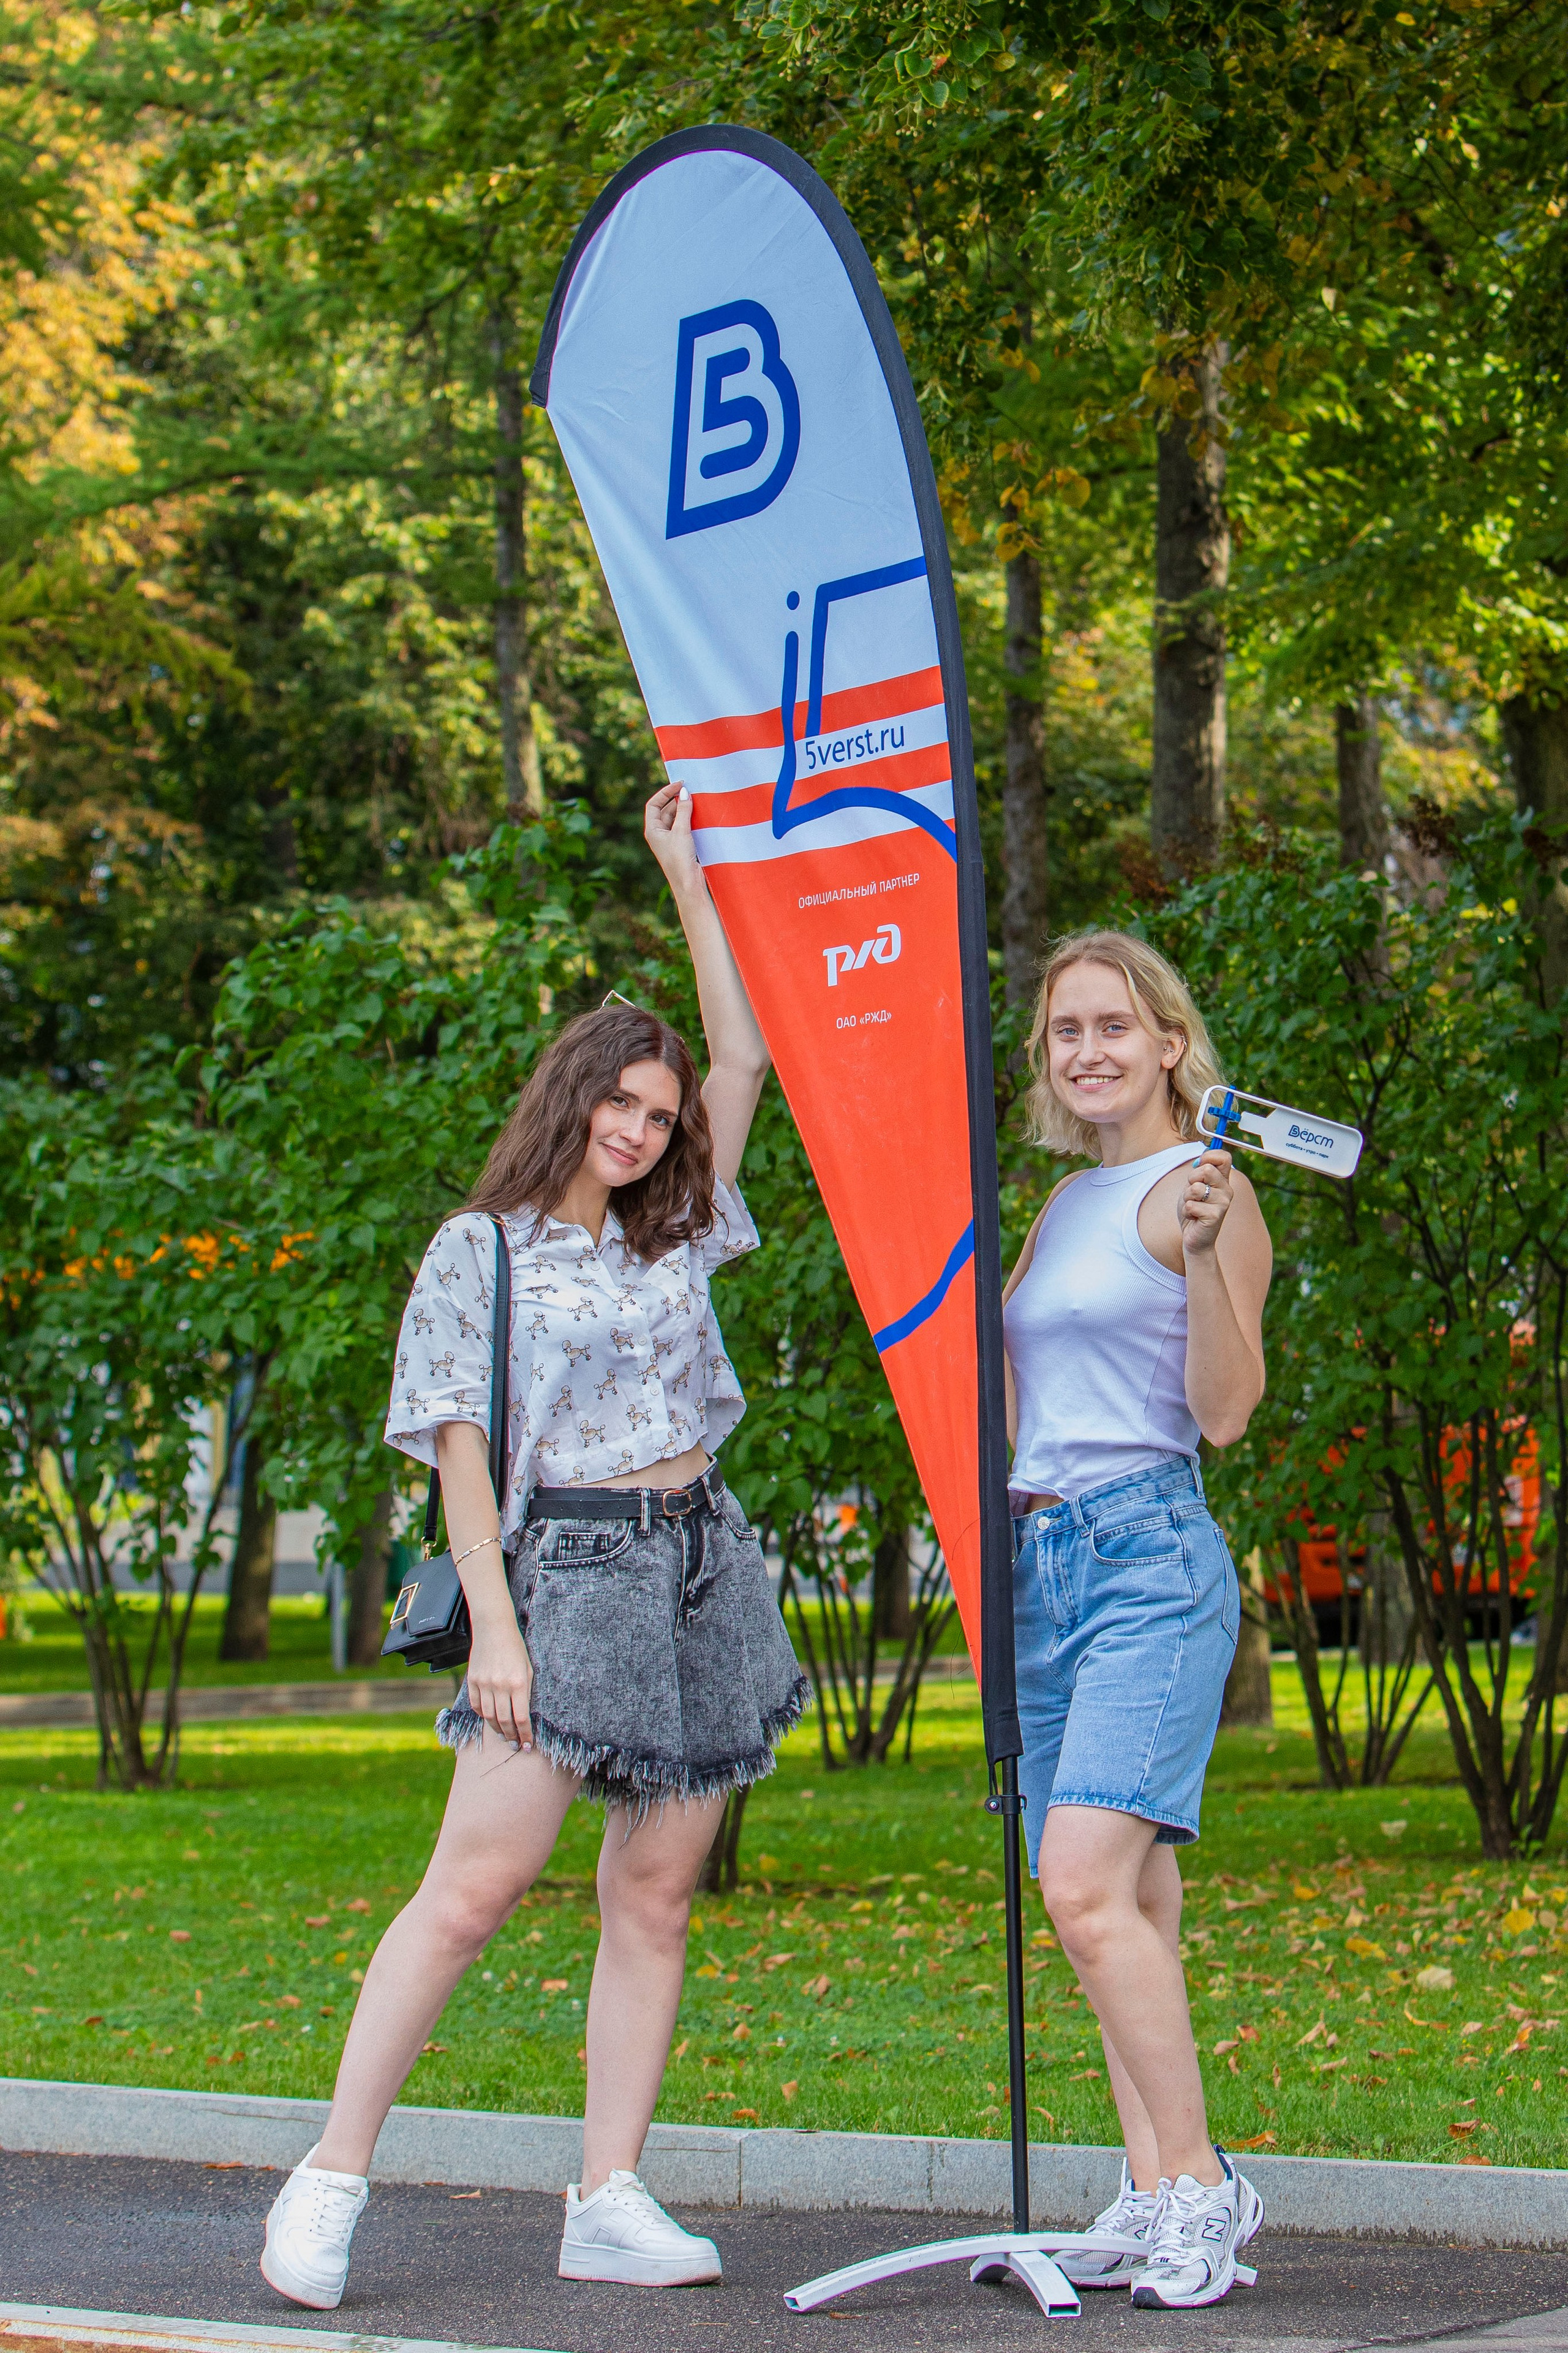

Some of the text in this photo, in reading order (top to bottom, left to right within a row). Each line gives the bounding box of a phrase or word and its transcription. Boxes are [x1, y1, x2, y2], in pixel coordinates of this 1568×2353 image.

[805, 725, 905, 770] 5verst.ru
[798, 873, 920, 908] ОФИЦИАЛЬНЫЙ ПАРТНЕР
[836, 1015, 856, 1029] ОАО
